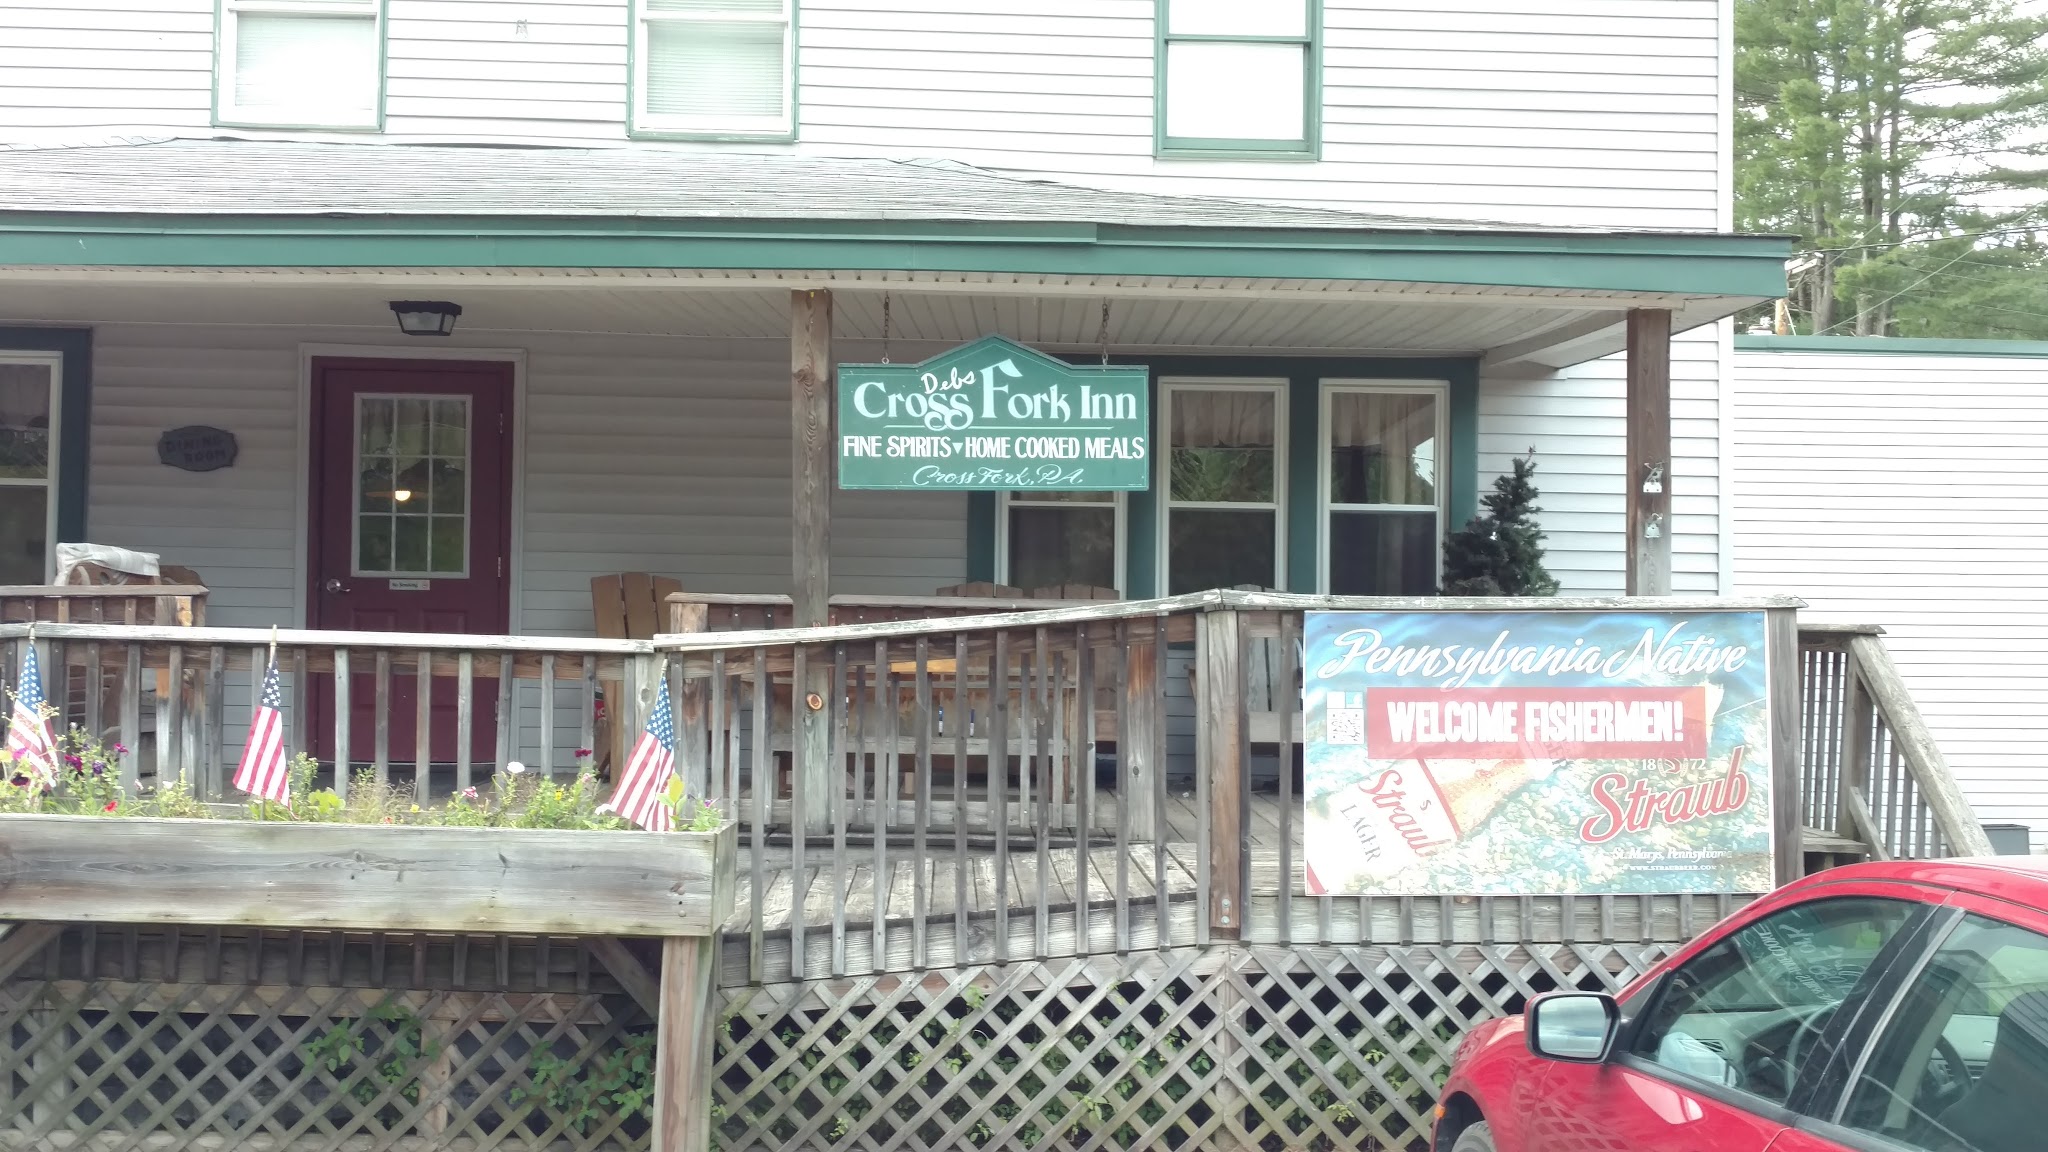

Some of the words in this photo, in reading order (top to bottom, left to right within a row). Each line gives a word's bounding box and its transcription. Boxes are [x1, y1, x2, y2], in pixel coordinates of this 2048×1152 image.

[853, 382, 974, 431] Cross
[979, 358, 1071, 423] Fork
[1079, 385, 1138, 420] Inn
[920, 367, 977, 395] Debs
[843, 436, 882, 457] FINE
[886, 436, 952, 457] SPIRITS
[965, 437, 1011, 458] HOME
[1014, 437, 1080, 459] COOKED
[1085, 437, 1145, 459] MEALS
[912, 465, 978, 486] Cross
[1317, 627, 1605, 693] Pennsylvania
[1601, 620, 1748, 678] Native
[1386, 701, 1518, 743] WELCOME
[1525, 701, 1684, 743] FISHERMEN!
[1642, 759, 1656, 771] 18
[1690, 759, 1706, 770] 72
[1580, 745, 1750, 845] Straub
